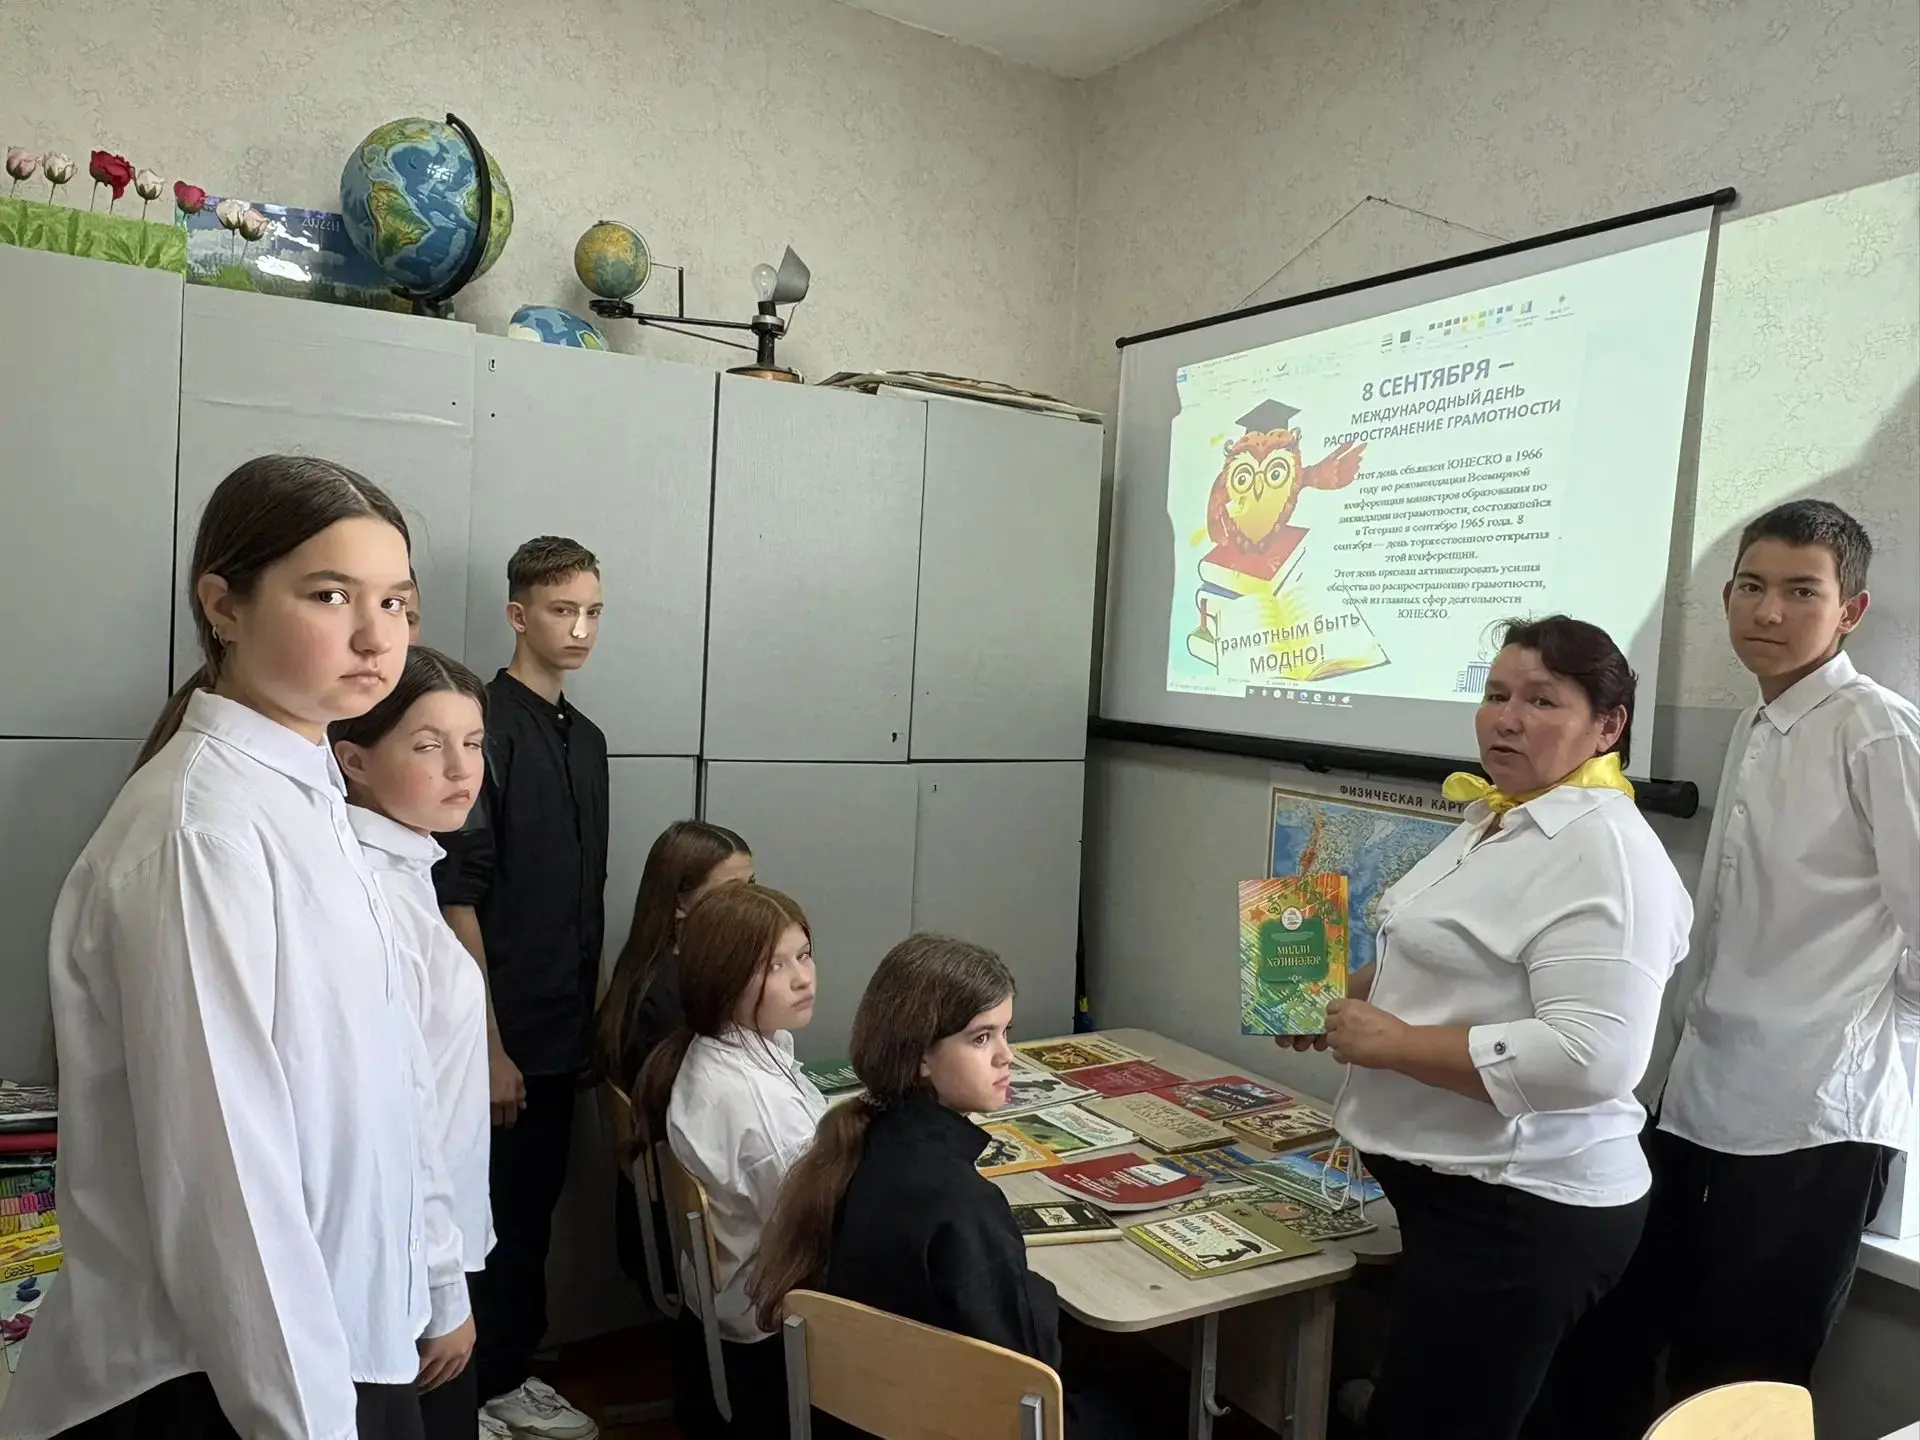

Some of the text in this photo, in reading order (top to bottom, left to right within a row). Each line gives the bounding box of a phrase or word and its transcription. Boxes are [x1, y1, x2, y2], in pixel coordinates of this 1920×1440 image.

[1362, 382, 1374, 401] 8
[1379, 358, 1491, 398] СЕНТЯБРЯ
[1351, 384, 1525, 426] МЕЖДУНАРОДНЫЙ ДЕНЬ
[1323, 399, 1561, 447] РАСПРОСТРАНЕНИЕ ГРАМОТНОСТИ
[1447, 453, 1502, 470] ЮНЕСКО
[1505, 455, 1512, 463] в
[1515, 447, 1543, 462] 1966
[1359, 484, 1379, 496] году
[1381, 483, 1393, 492] по
[1467, 467, 1531, 484] Всемирной
[1406, 490, 1460, 504] министров
[1532, 482, 1548, 492] по
[1460, 516, 1485, 529] 1965
[1487, 517, 1513, 528] года.
[1517, 514, 1524, 525] 8
[1386, 539, 1408, 550] день
[1385, 553, 1406, 563] этой
[1334, 568, 1354, 579] Этот
[1355, 569, 1377, 579] день
[1369, 584, 1381, 592] по
[1422, 594, 1447, 607] сфер
[1397, 608, 1449, 619] ЮНЕСКО
[1214, 613, 1361, 656] Грамотным быть
[1250, 643, 1325, 674] МОДНО!
[1339, 785, 1467, 814] ФИЗИЧЕСКАЯ КАРТ
[1277, 944, 1310, 955] МИЛЛИ
[1156, 1223, 1198, 1247] МОКРАЯ
[1176, 1218, 1206, 1236] ВОДА
[1195, 1214, 1240, 1237] ПОЧЕМУ
